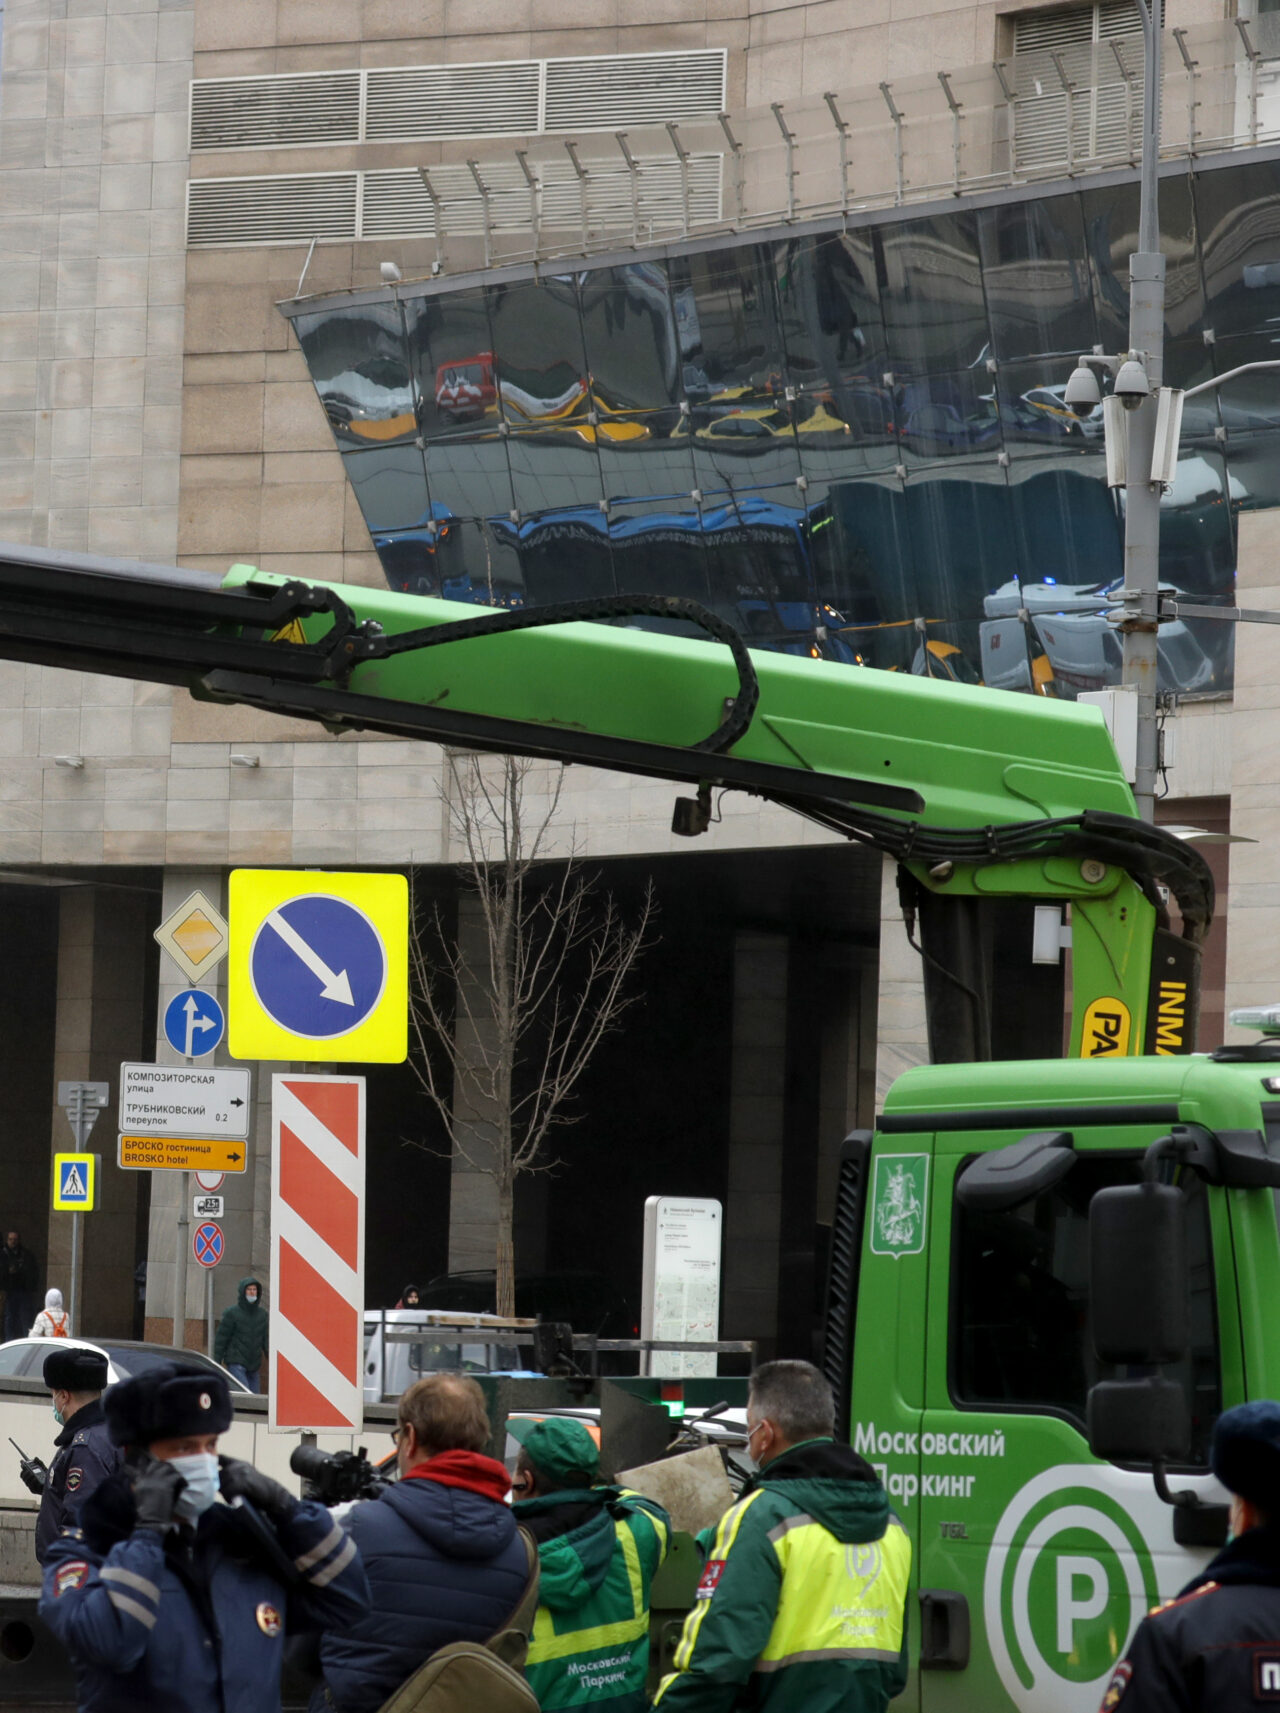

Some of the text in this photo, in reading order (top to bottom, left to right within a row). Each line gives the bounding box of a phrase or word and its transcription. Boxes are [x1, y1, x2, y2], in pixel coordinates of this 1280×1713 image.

[1090, 1011, 1122, 1057] PA
[127, 1072, 215, 1085] КОМПОЗИТОРСКАЯ
[127, 1085, 154, 1094] улица
[127, 1103, 206, 1115] ТРУБНИКОВСКИЙ
[126, 1116, 168, 1126] переулок
[125, 1140, 211, 1154] БРОСКО гостиница
[125, 1153, 188, 1164] BROSKO hotel
[854, 1421, 1005, 1457] Московский
[939, 1520, 969, 1540] TGL
[1056, 1555, 1110, 1654] P
[567, 1651, 632, 1676] Московский
[580, 1671, 626, 1689] Паркинг
